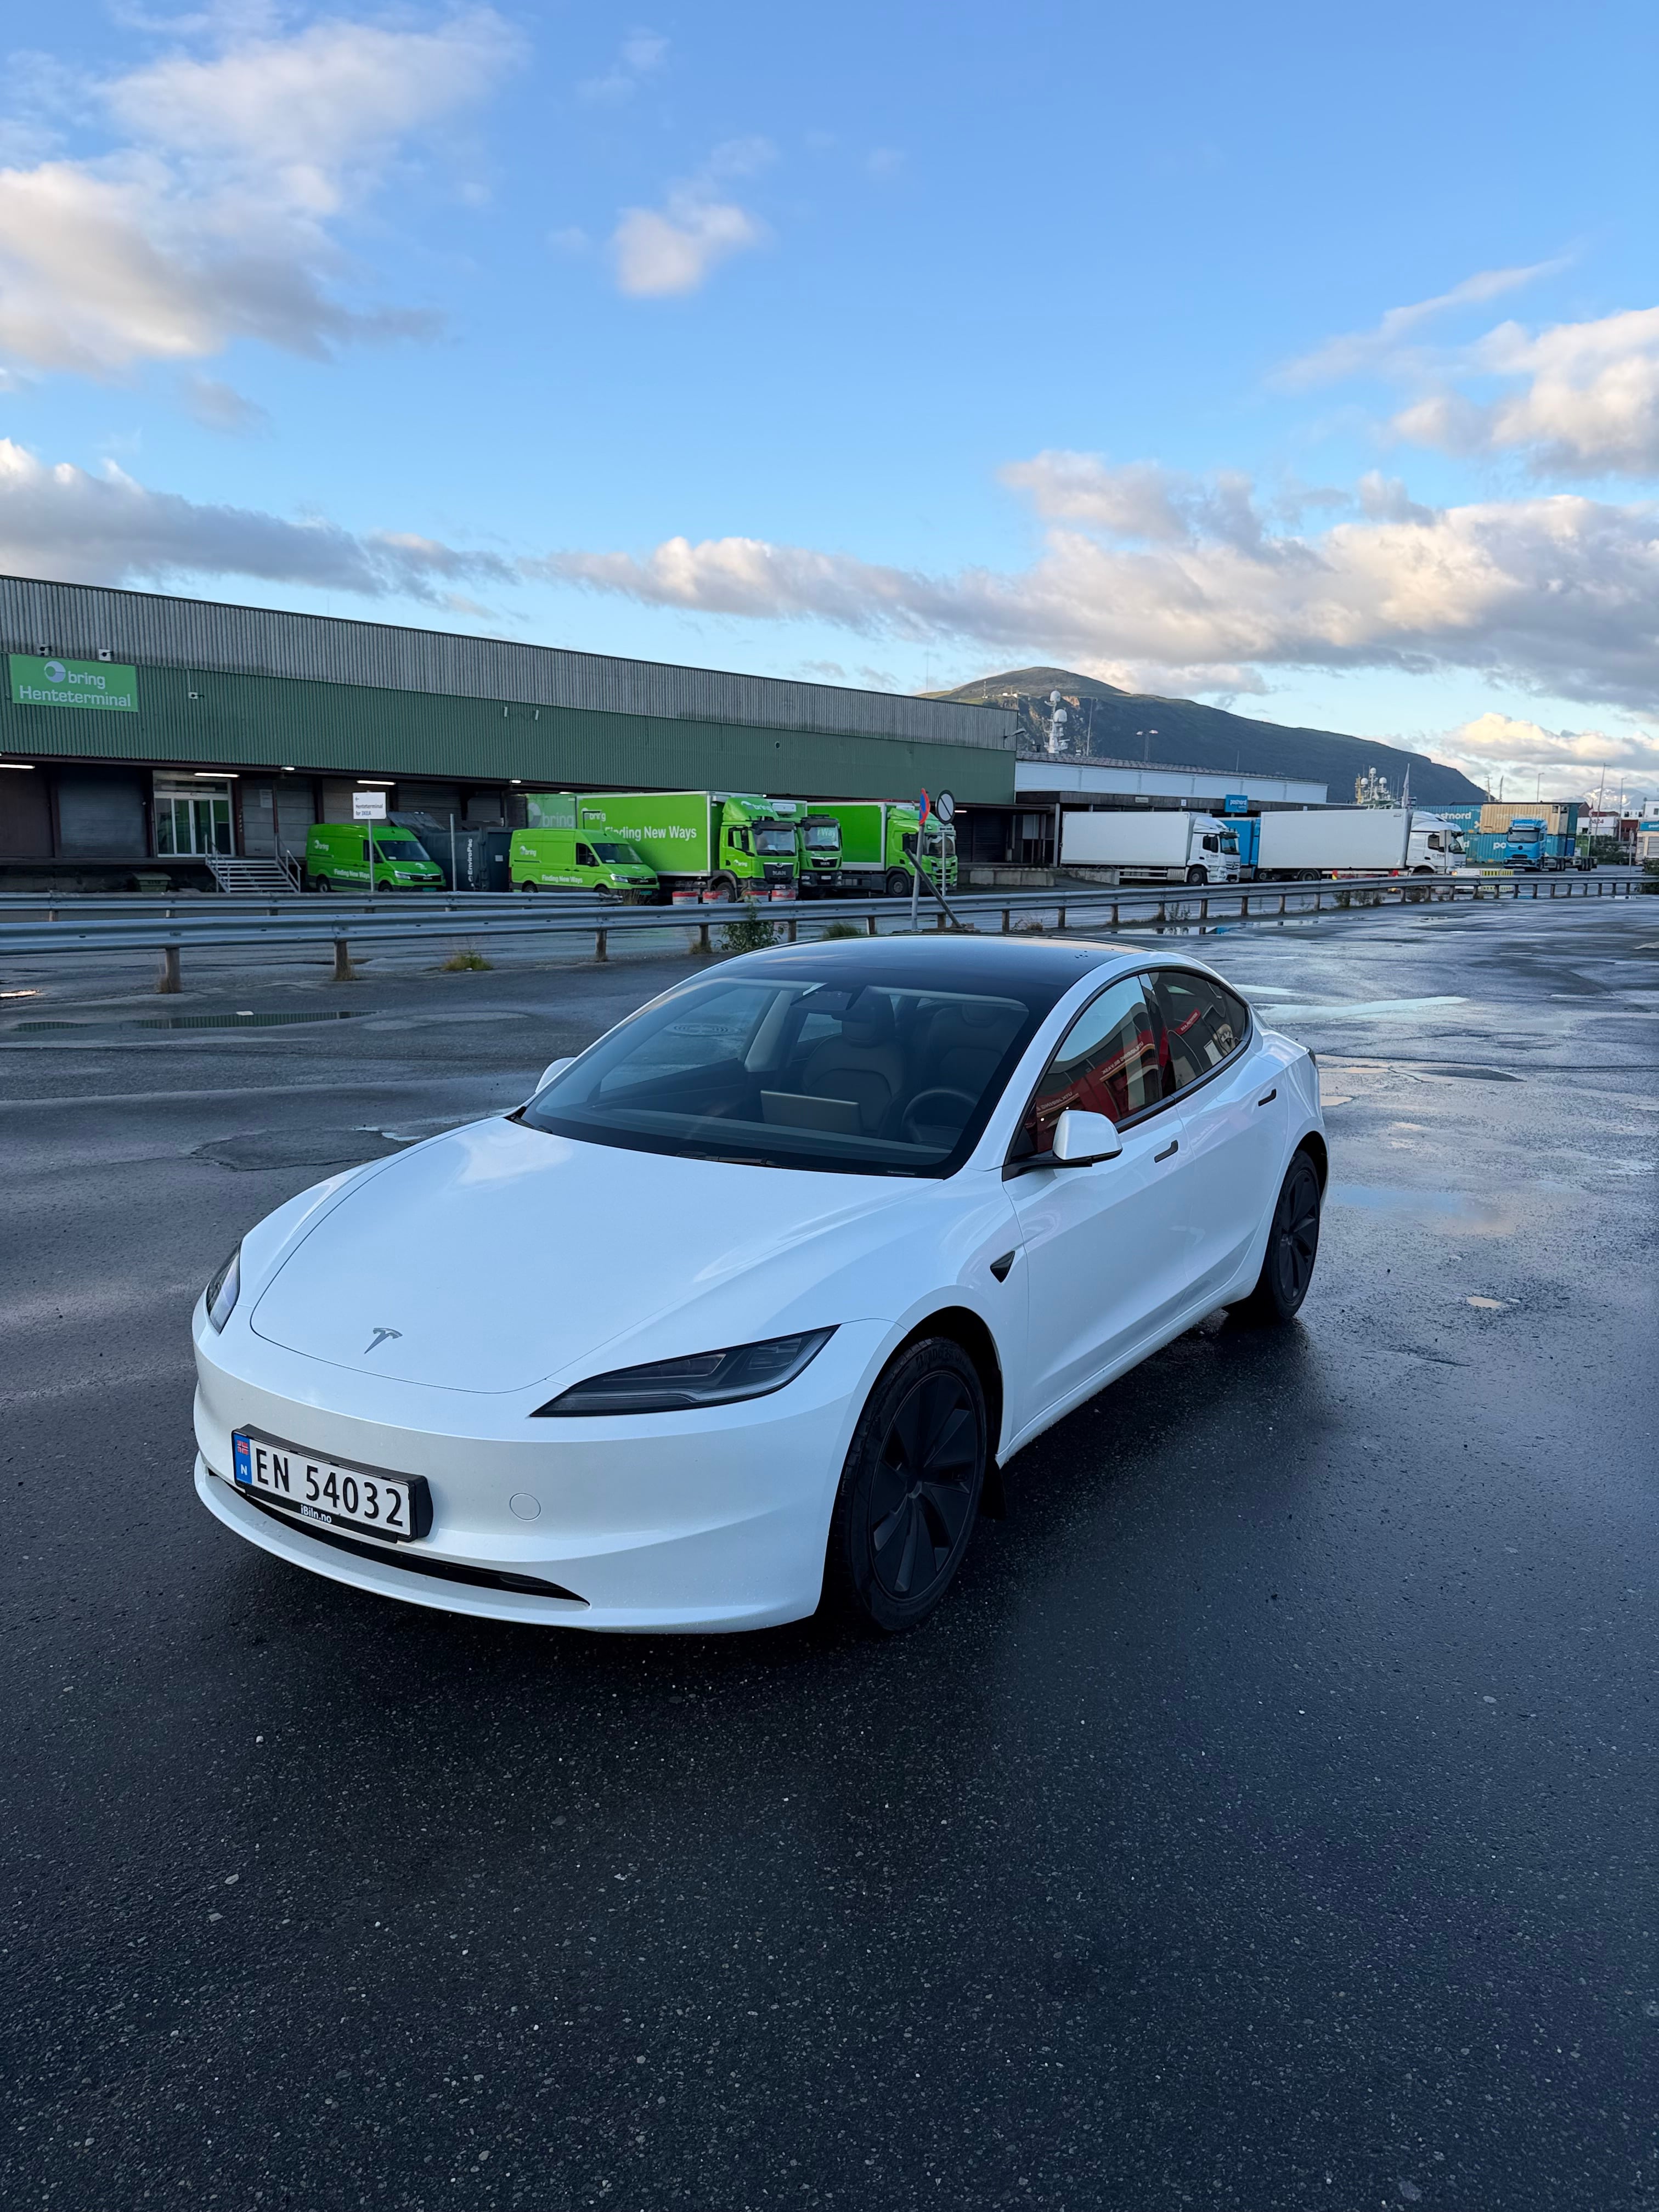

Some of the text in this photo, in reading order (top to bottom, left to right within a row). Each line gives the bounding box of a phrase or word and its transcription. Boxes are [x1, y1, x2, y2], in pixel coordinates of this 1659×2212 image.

[67, 670, 106, 690] bring
[19, 685, 131, 707] Henteterminal
[754, 803, 774, 812] bring
[542, 811, 574, 828] bring
[605, 825, 697, 841] ding New Ways
[823, 827, 836, 838] Way
[524, 848, 537, 857] bring
[334, 868, 349, 877] Finding
[541, 874, 558, 883] Finding
[240, 1463, 247, 1476] N
[256, 1447, 403, 1527] EN 54032
[300, 1504, 332, 1524] iBiln.no
